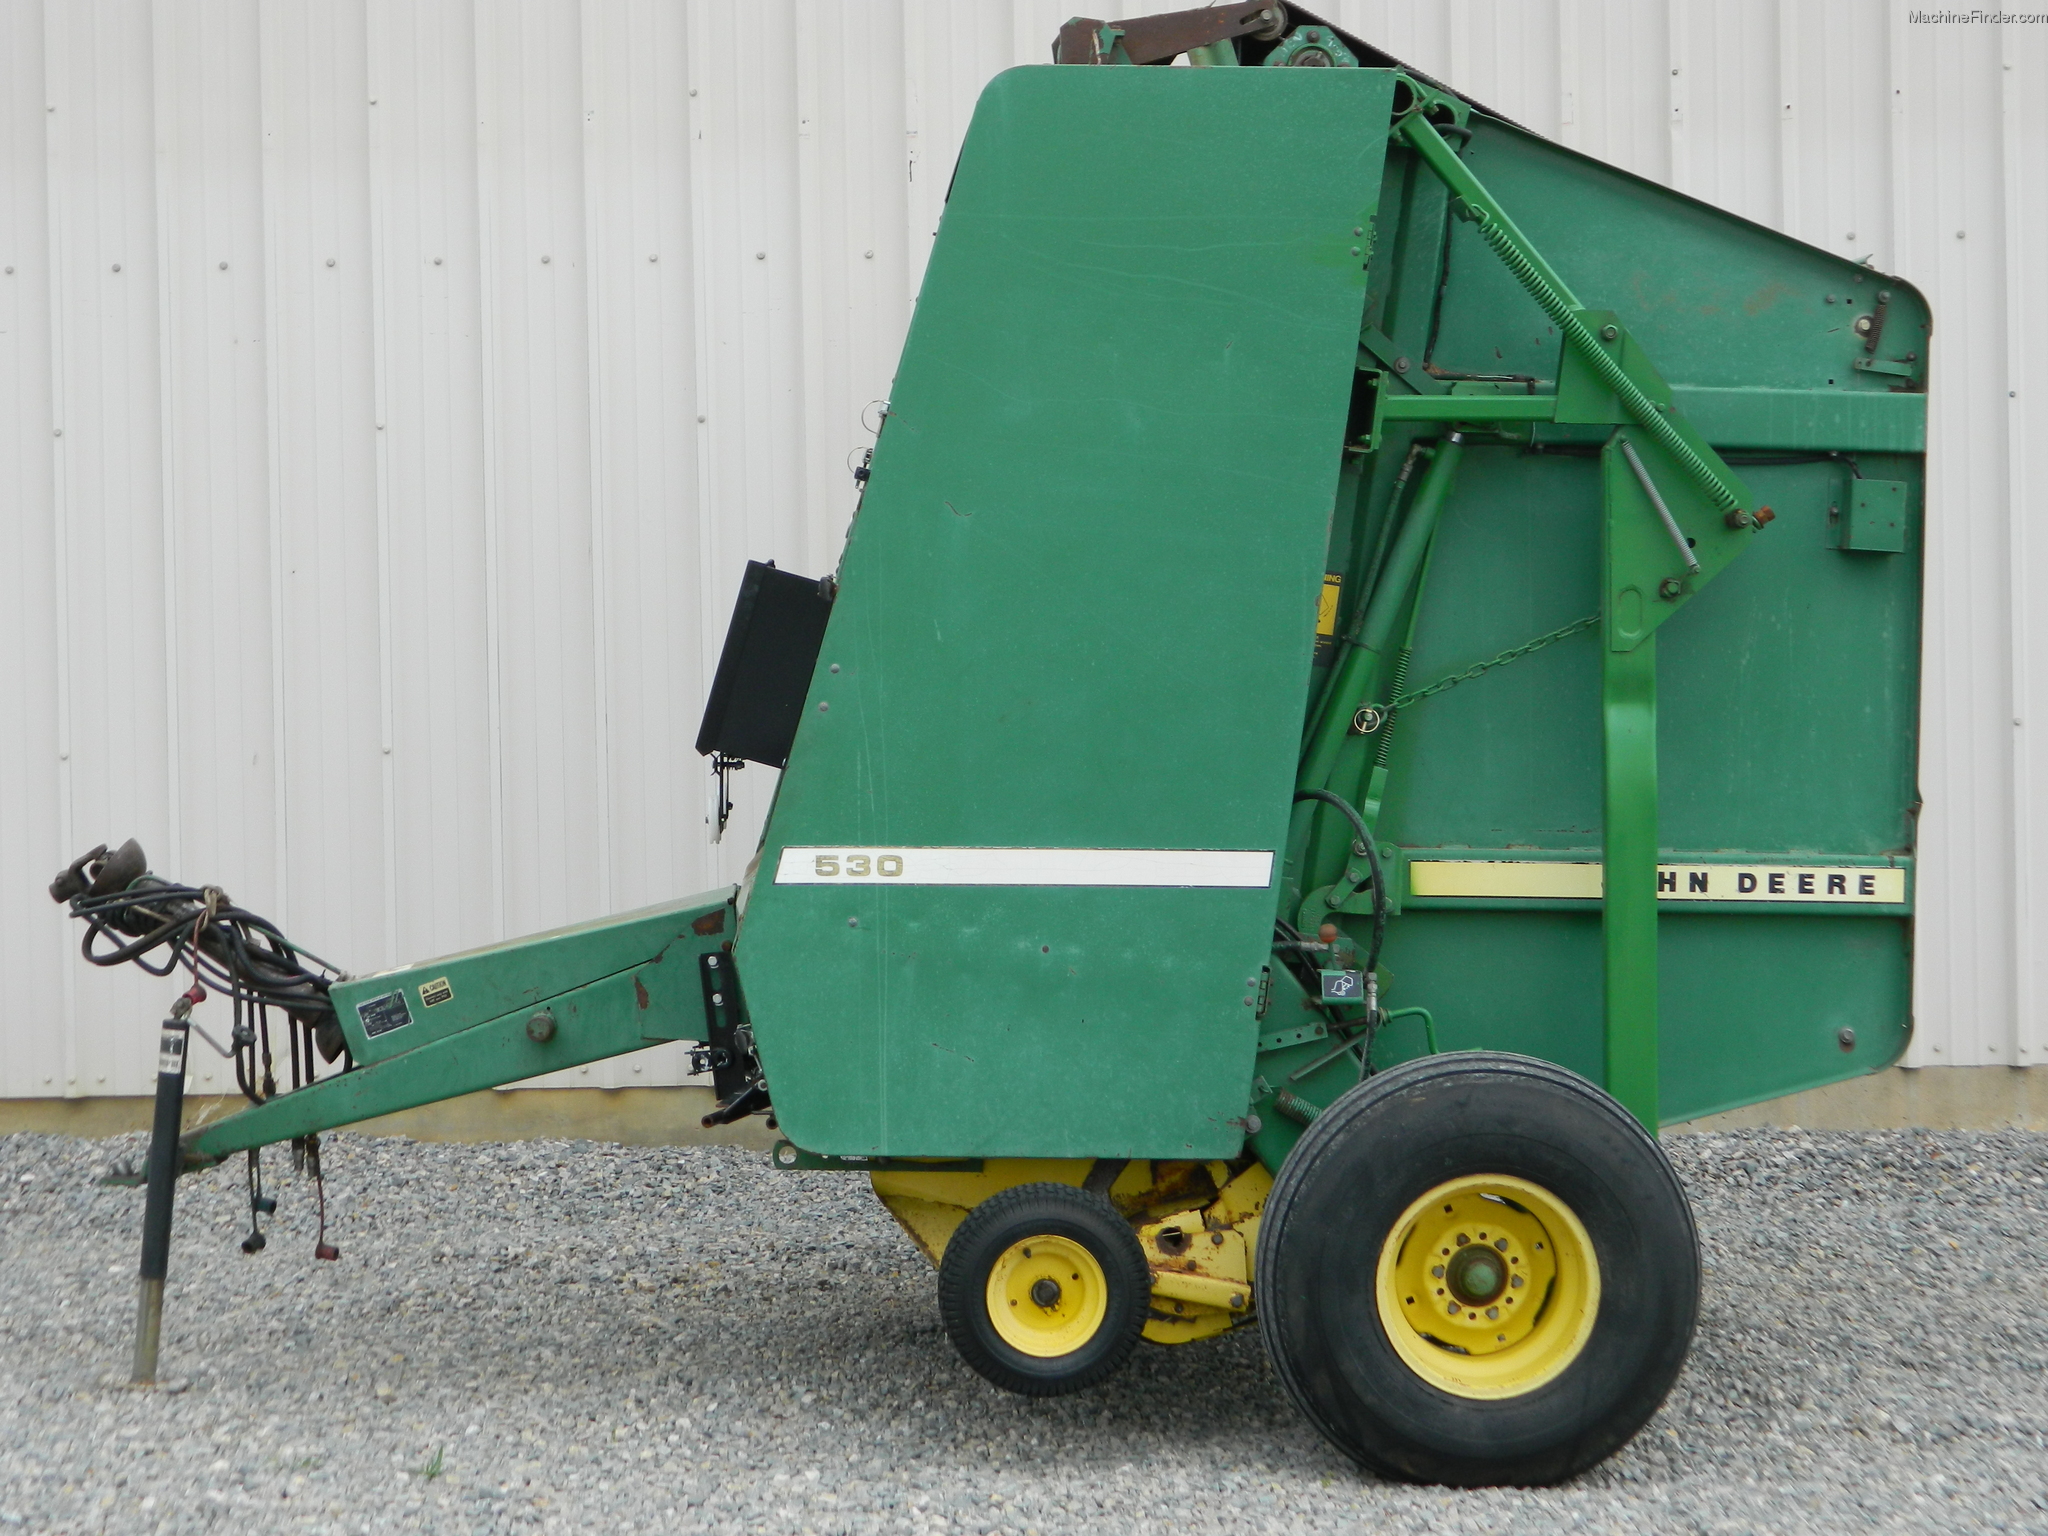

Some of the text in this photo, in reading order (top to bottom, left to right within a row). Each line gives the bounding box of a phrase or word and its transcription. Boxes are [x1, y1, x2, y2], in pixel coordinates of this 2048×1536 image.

[815, 854, 904, 877] 530
[1657, 871, 1876, 896] HN DEERE
